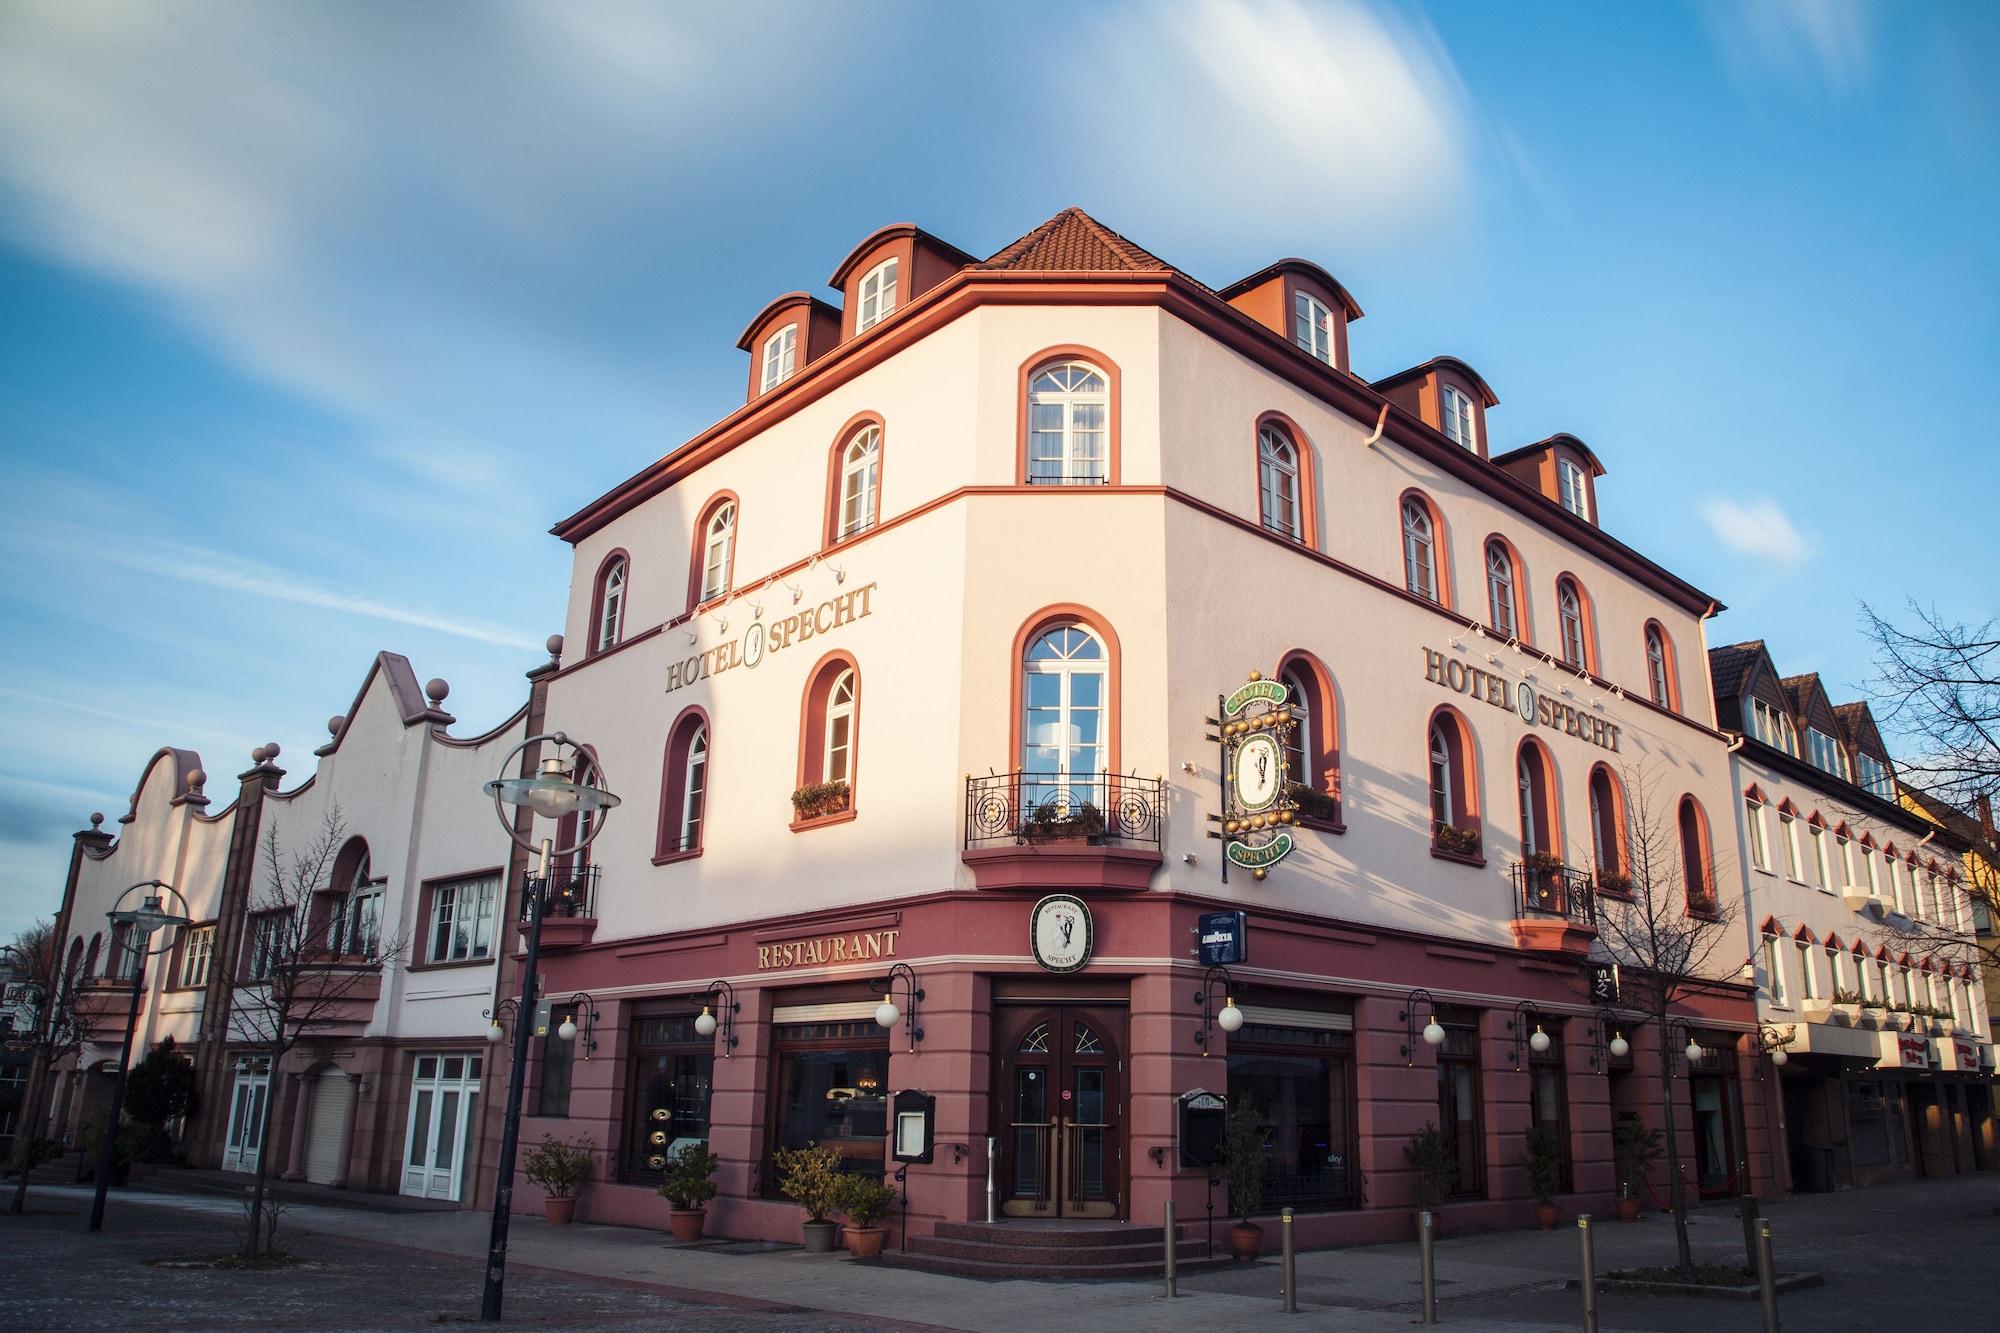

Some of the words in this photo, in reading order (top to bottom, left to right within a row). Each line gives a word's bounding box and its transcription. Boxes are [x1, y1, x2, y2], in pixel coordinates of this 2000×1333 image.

[665, 639, 743, 693] HOTEL
[768, 581, 878, 653] SPECHT
[1232, 684, 1276, 705] HOTEL
[1422, 646, 1515, 712] HOTEL
[1537, 694, 1620, 752] SPECHT
[1235, 841, 1281, 864] SPECHT
[758, 930, 900, 969] RESTAURANT
[1046, 954, 1077, 964] SPECHT
[1595, 969, 1611, 998] sky
[1327, 1154, 1342, 1165] sky
